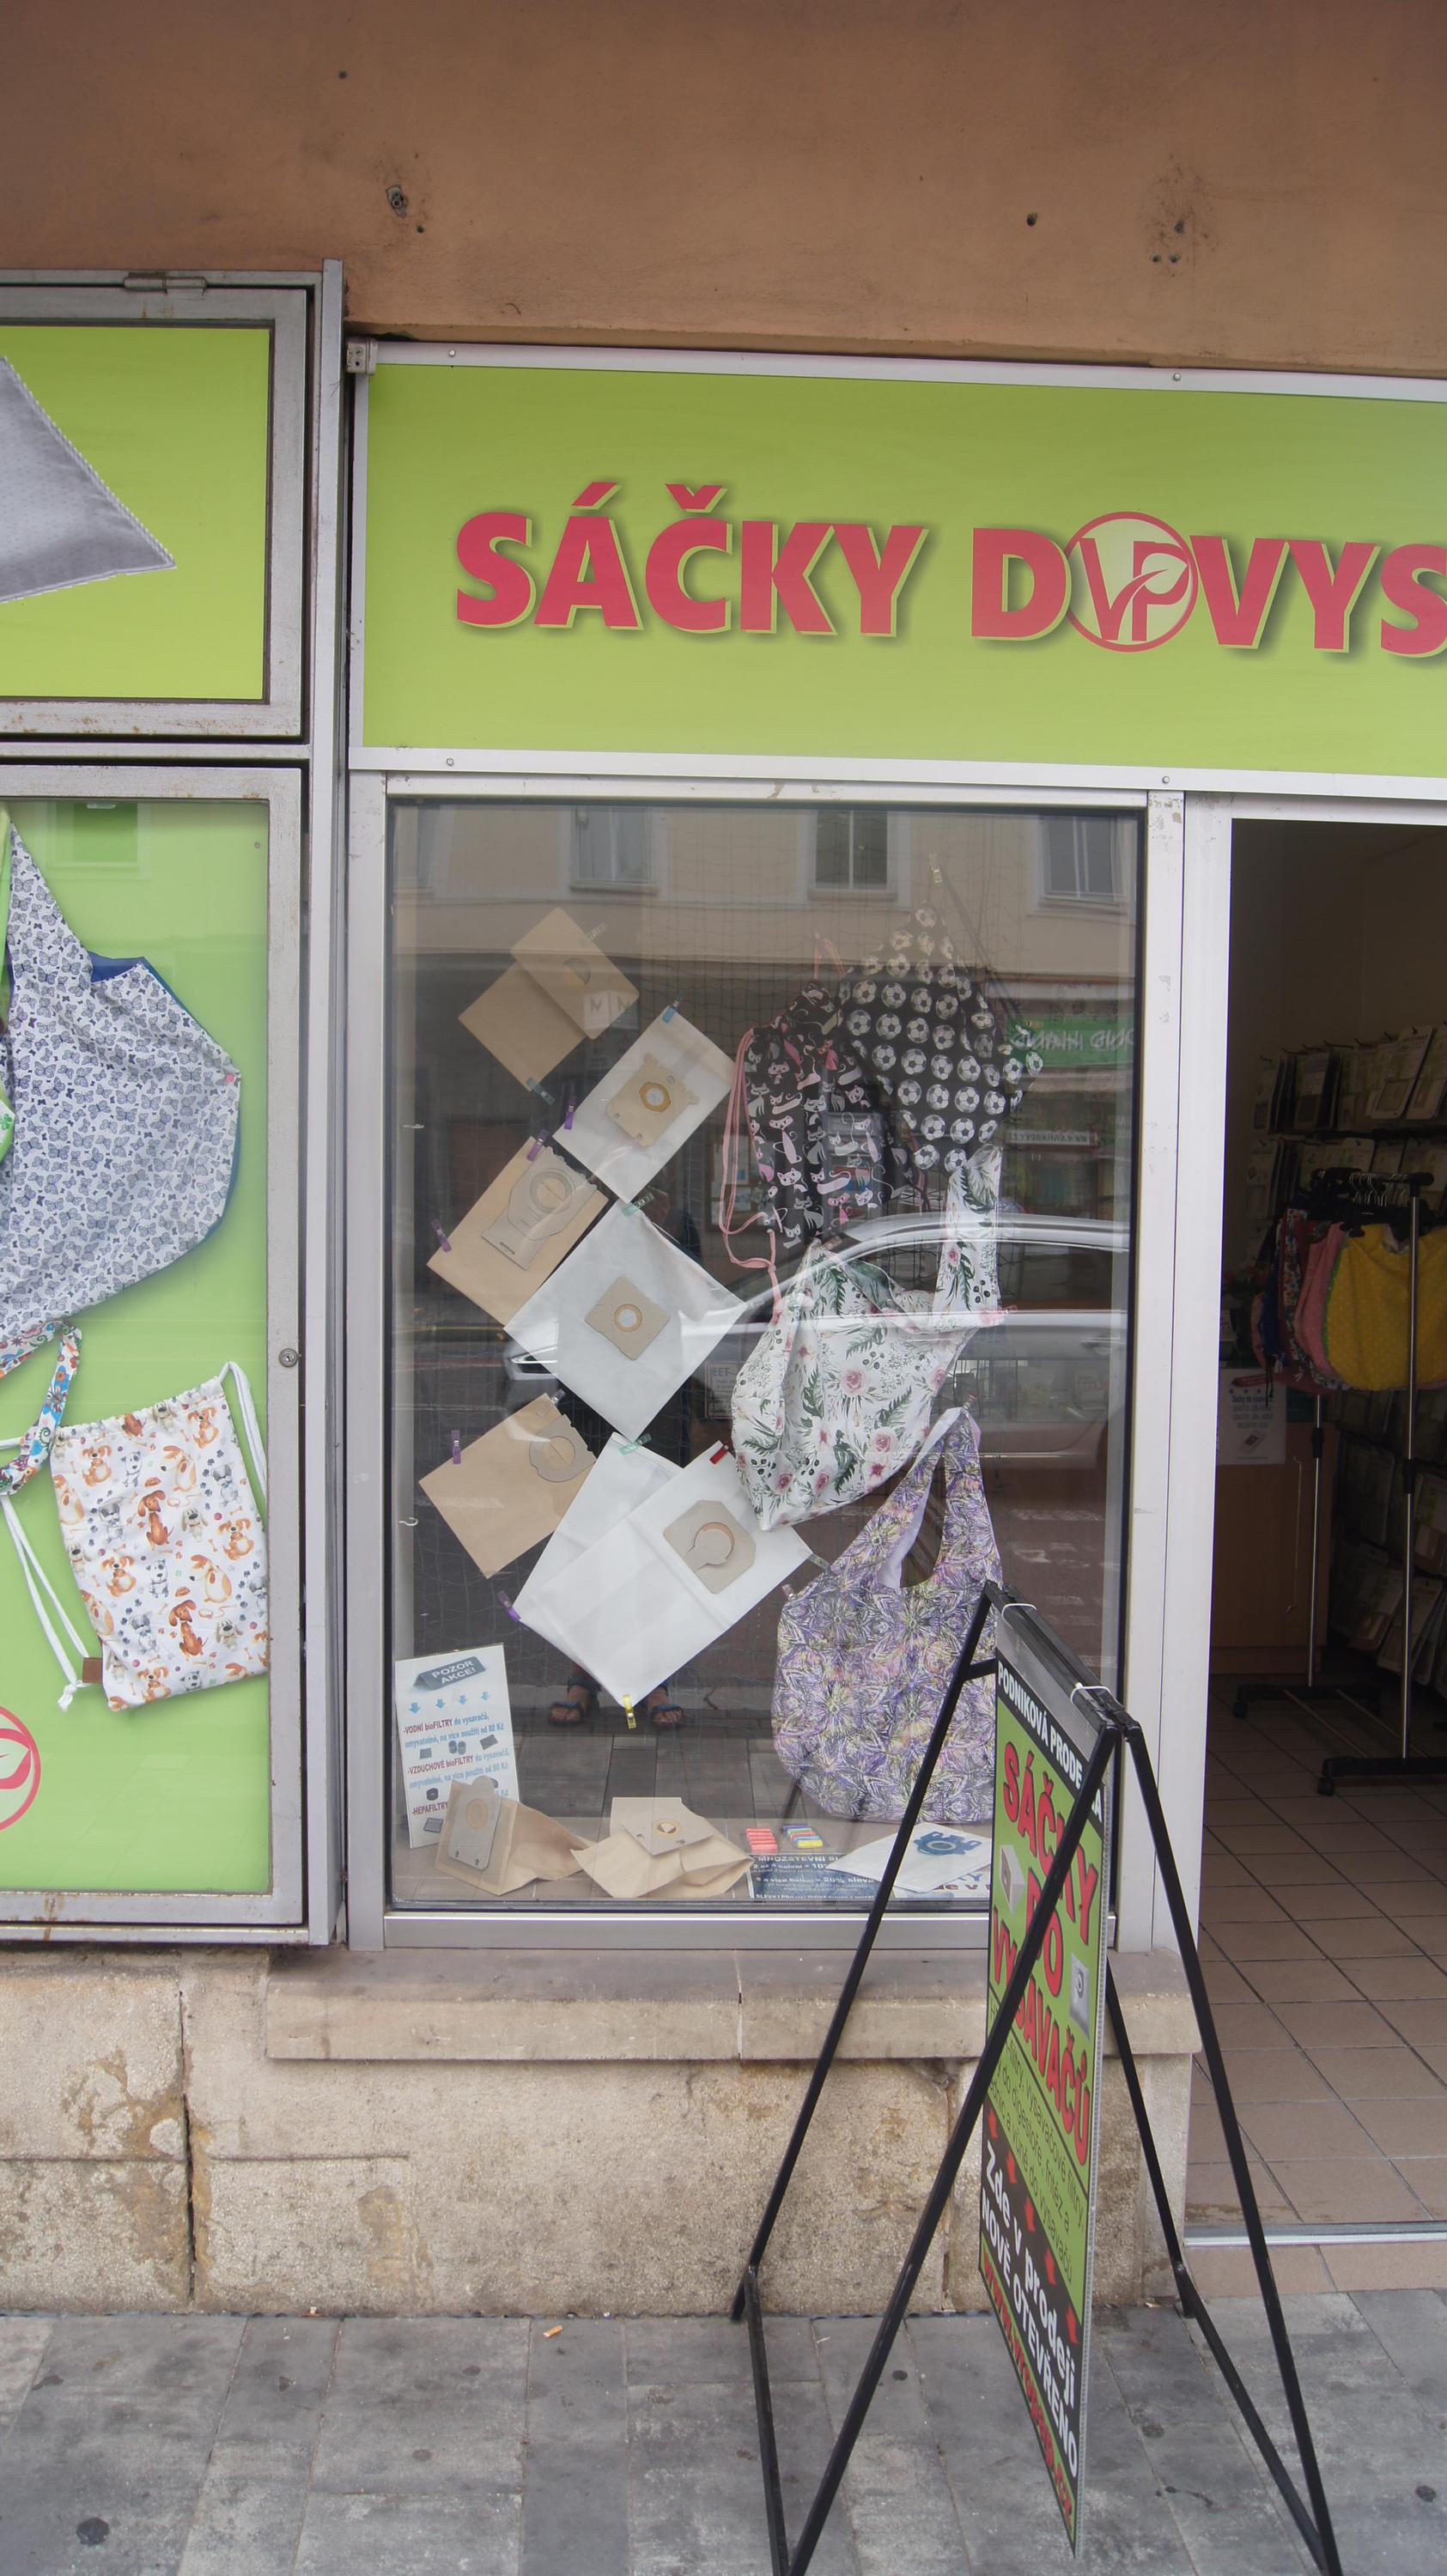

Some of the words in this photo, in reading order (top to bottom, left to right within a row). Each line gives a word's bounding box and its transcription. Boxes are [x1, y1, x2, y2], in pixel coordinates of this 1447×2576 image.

[456, 480, 927, 637] SÁČKY
[431, 1660, 475, 1679] POZOR
[441, 1668, 476, 1684] AKCE!
[998, 1661, 1049, 1748] PODNIKOVÁ
[1050, 1725, 1103, 1824] PRODEA
[982, 2190, 1011, 2287] NOVĚ
[1013, 2273, 1078, 2477] OTEVŘENO
[986, 2140, 1011, 2227] Zde
[1012, 2215, 1022, 2255] v
[1025, 2246, 1074, 2409] prodeji
